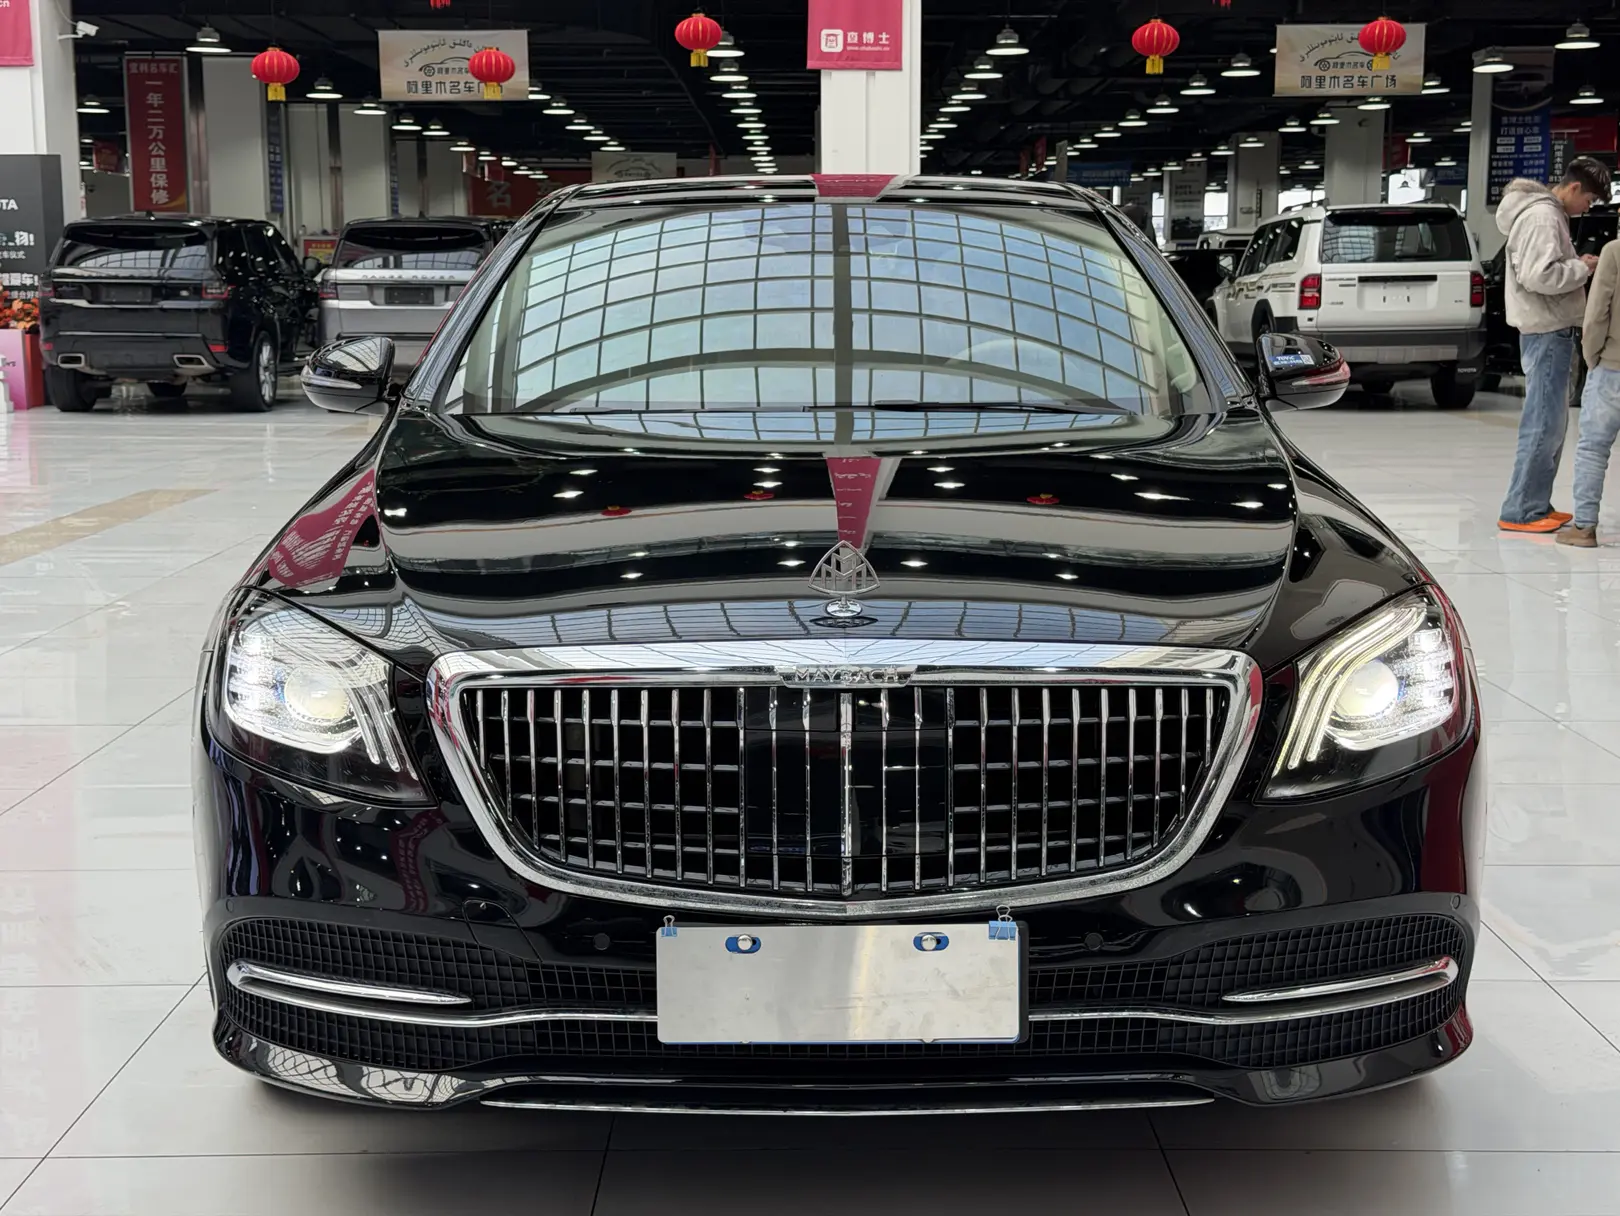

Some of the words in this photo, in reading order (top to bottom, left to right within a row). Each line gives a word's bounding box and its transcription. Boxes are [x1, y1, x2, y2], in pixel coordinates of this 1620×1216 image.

[846, 31, 890, 44] 查博士
[1301, 75, 1397, 88] 阿里木名车广场
[145, 80, 170, 205] 一年二万公里保修
[0, 198, 19, 210] TA
[795, 667, 899, 682] MAYBACH
